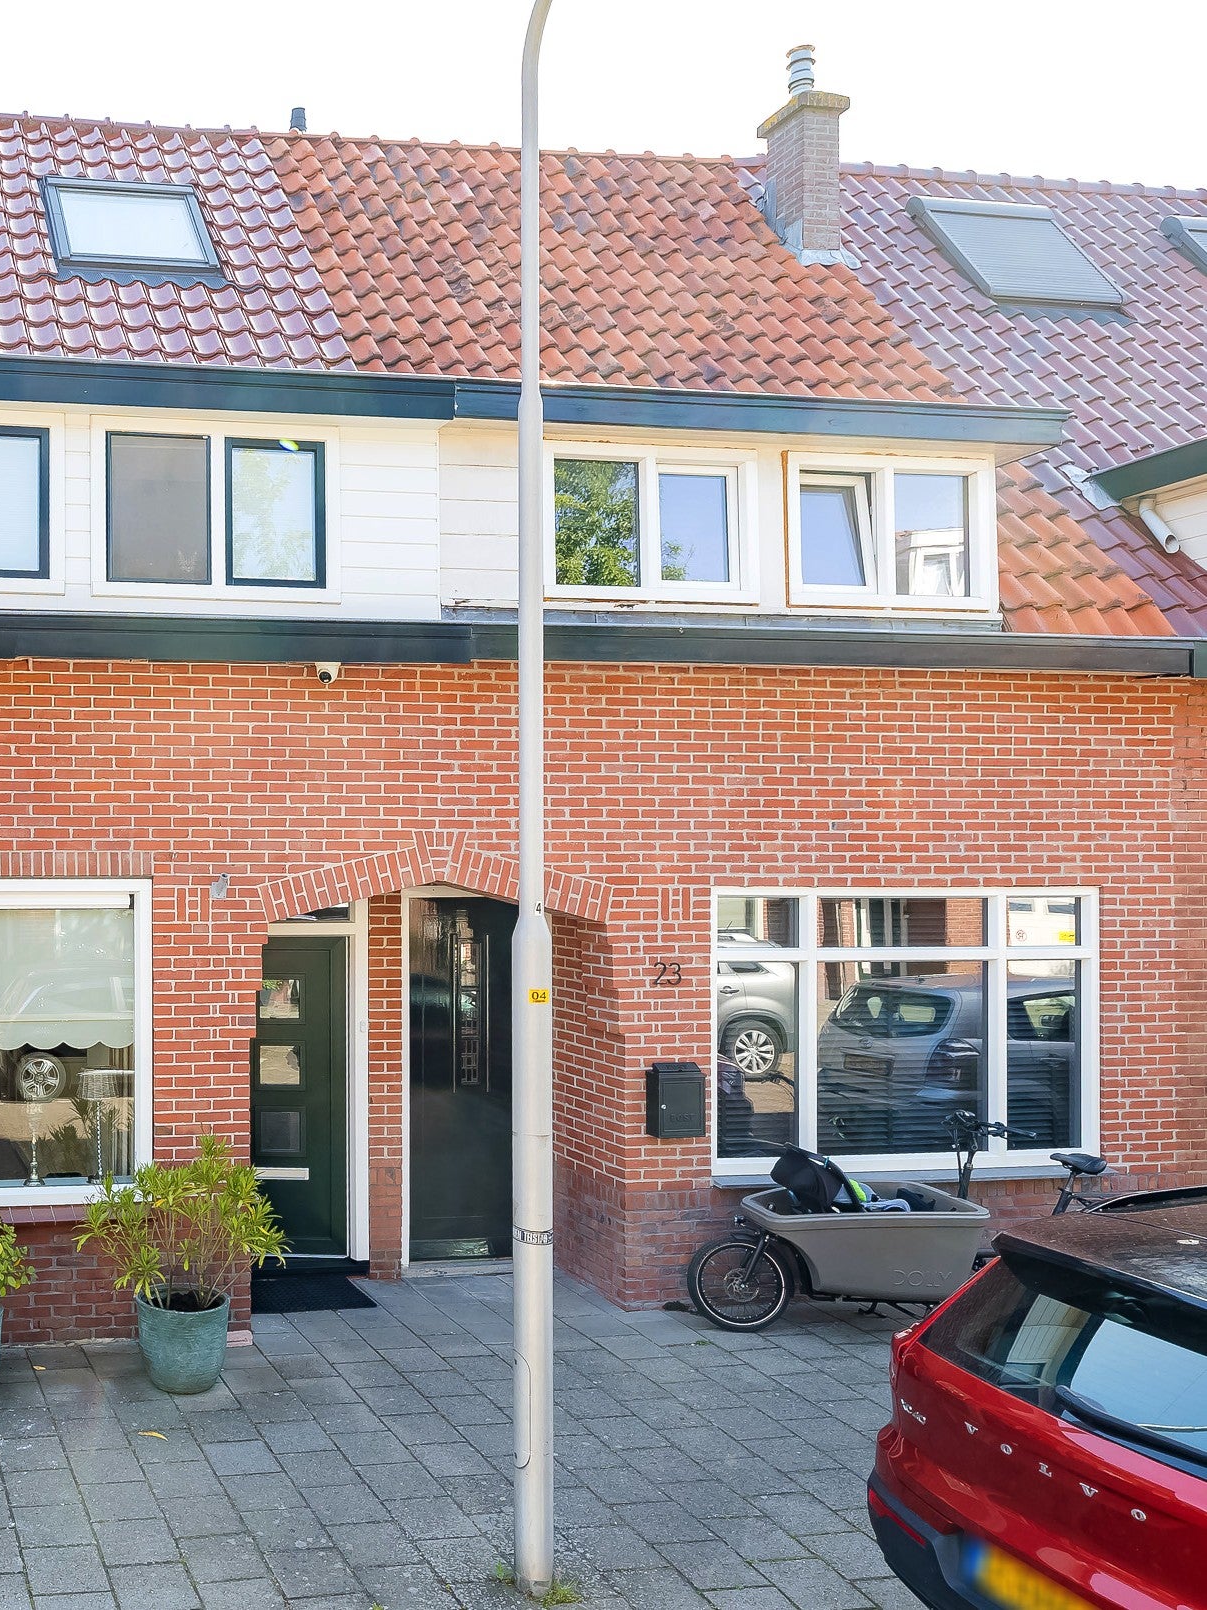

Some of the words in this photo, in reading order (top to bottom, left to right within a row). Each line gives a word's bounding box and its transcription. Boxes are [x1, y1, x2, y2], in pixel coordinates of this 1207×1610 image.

[535, 902, 542, 914] 4
[654, 962, 682, 986] 23
[531, 991, 547, 1000] 04
[892, 1269, 953, 1288] DOLLY
[964, 1421, 1147, 1522] VOLVO
